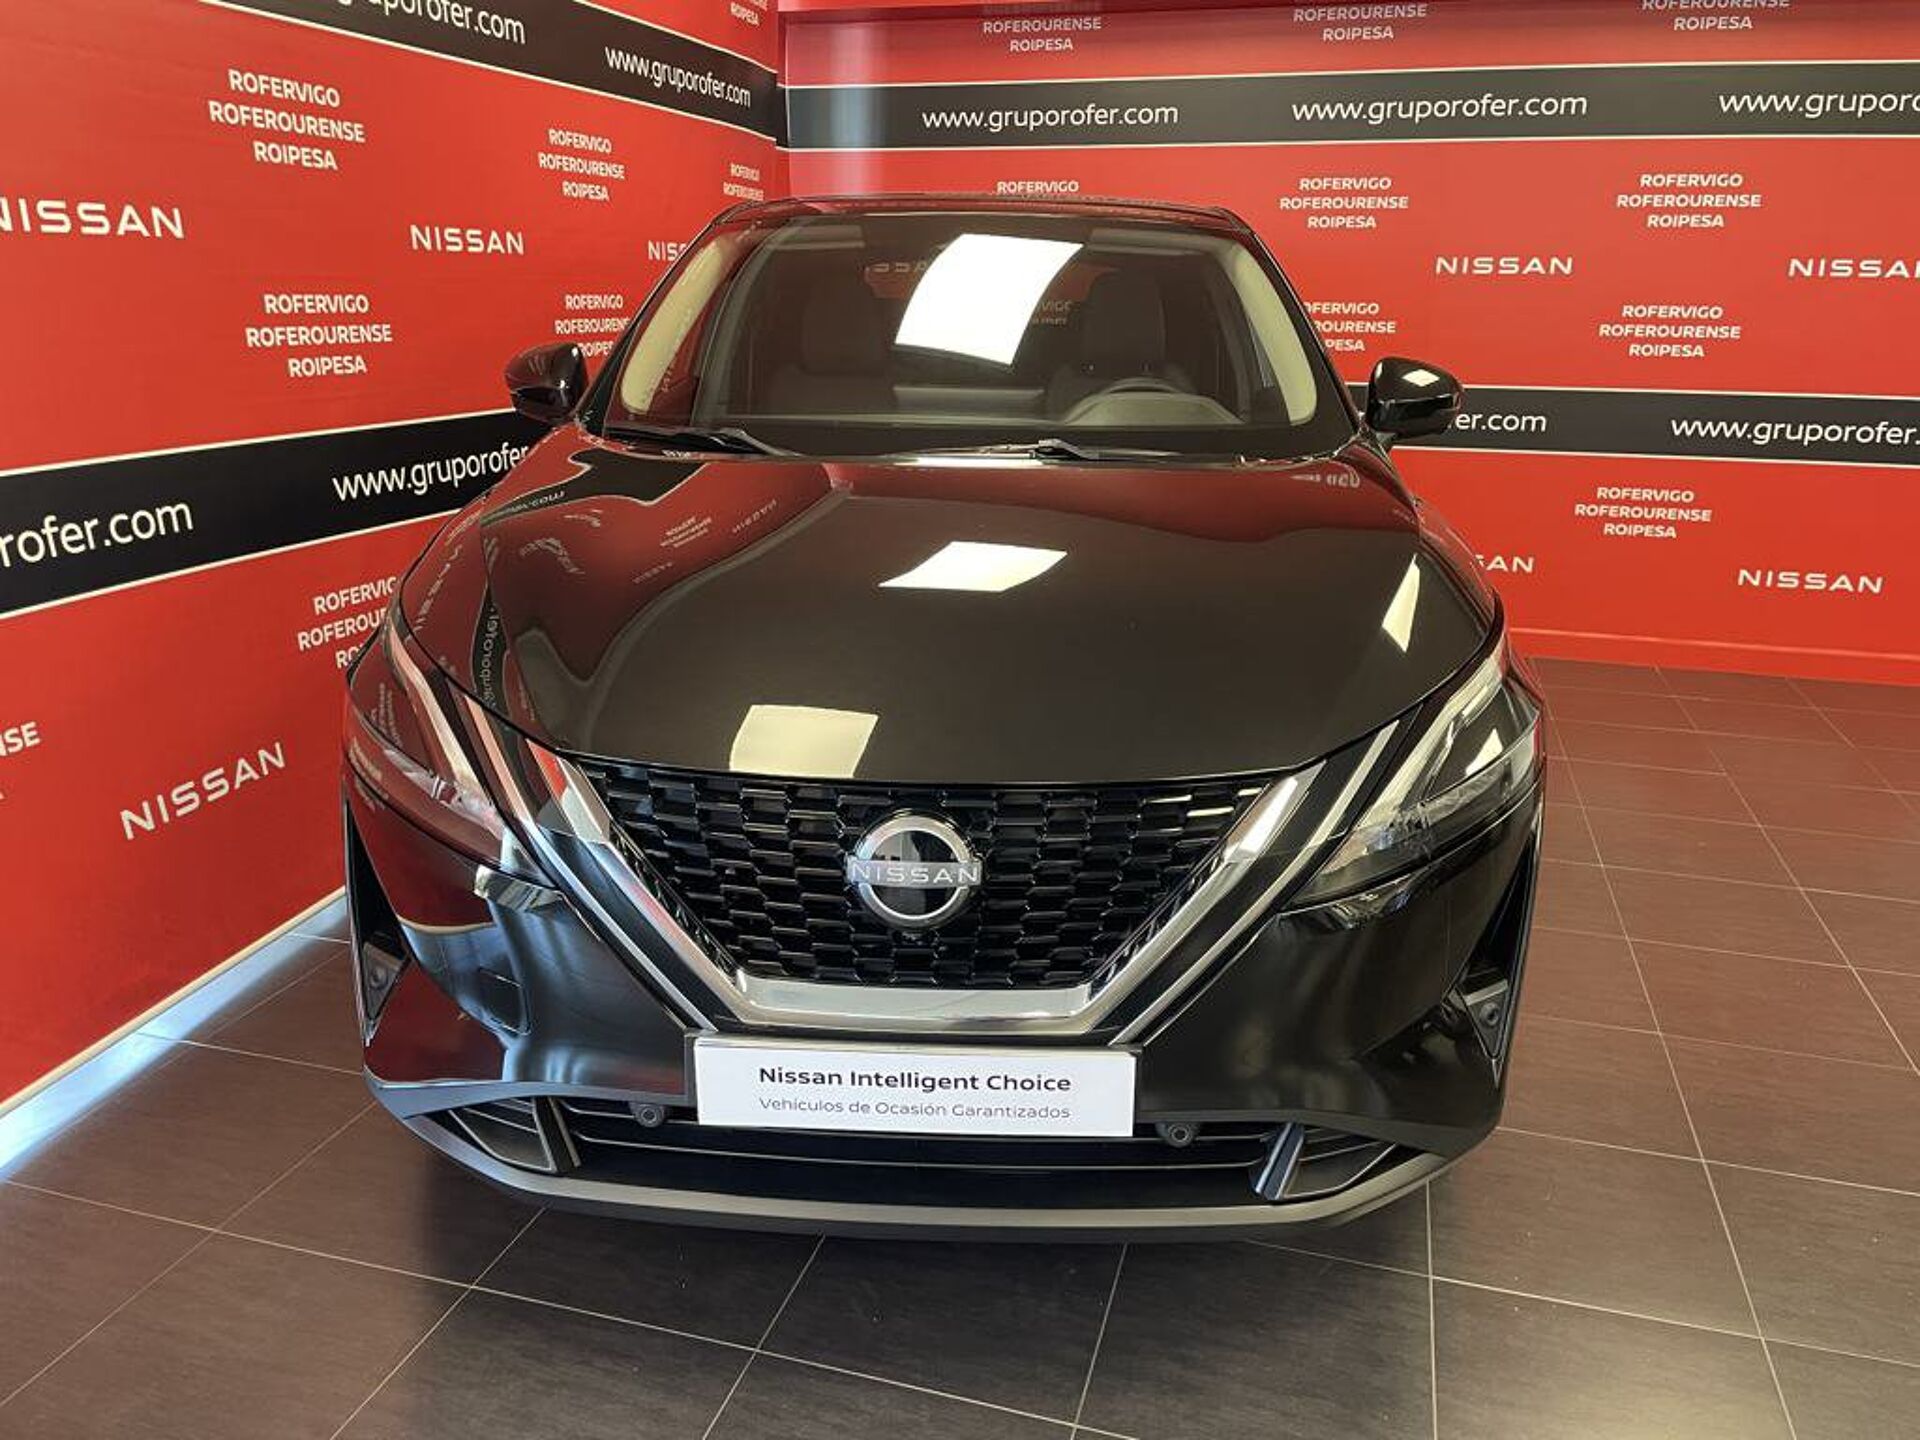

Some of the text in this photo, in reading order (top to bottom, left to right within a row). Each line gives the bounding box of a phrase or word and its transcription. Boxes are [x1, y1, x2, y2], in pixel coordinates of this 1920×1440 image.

[1293, 4, 1427, 22] ROFEROURENSE
[983, 17, 1102, 33] ROFEROURENSE
[1673, 16, 1753, 31] ROIPESA
[1323, 26, 1394, 41] ROIPESA
[1010, 39, 1073, 52] ROIPESA
[605, 46, 751, 108] www.gruporofer.com
[228, 68, 340, 108] ROFERVIGO
[922, 103, 1179, 131] www.gruporofer.com
[1292, 94, 1588, 125] www.gruporofer.com
[208, 100, 366, 143] ROFEROURENSE
[548, 128, 612, 154] ROFERVIGO
[253, 140, 338, 170] ROIPESA
[538, 151, 625, 180] ROFEROURENSE
[997, 180, 1079, 193] ROFERVIGO
[1299, 177, 1392, 191] ROFERVIGO
[1640, 173, 1744, 188] ROFERVIGO
[562, 181, 609, 201] ROIPESA
[1280, 195, 1409, 210] ROFEROURENSE
[1617, 193, 1762, 209] ROFEROURENSE
[1308, 215, 1377, 229] ROIPESA
[1647, 214, 1725, 229] ROIPESA
[410, 224, 525, 255] NISSAN
[1435, 256, 1573, 276] NISSAN
[1788, 258, 1920, 279] NISSA
[263, 293, 371, 314] ROFERVIGO
[565, 294, 624, 310] ROFERVIGO
[1621, 304, 1723, 320] ROFERVIGO
[246, 323, 393, 348] ROFEROURENSE
[1599, 324, 1741, 339] ROFEROURENSE
[1628, 344, 1705, 358] ROIPESA
[288, 355, 367, 378] ROIPESA
[1448, 413, 1547, 433] er.com
[1597, 487, 1695, 502] ROFERVIGO
[1574, 503, 1713, 522] ROFEROURENSE
[1603, 523, 1677, 538] ROIPESA
[1738, 569, 1883, 594] NISSAN
[120, 742, 286, 840] NISSAN
[851, 862, 979, 883] NISSAN
[759, 1067, 1072, 1093] Nissan Intelligent Choice
[849, 1101, 870, 1114] de
[952, 1104, 1071, 1119] Garantizados
